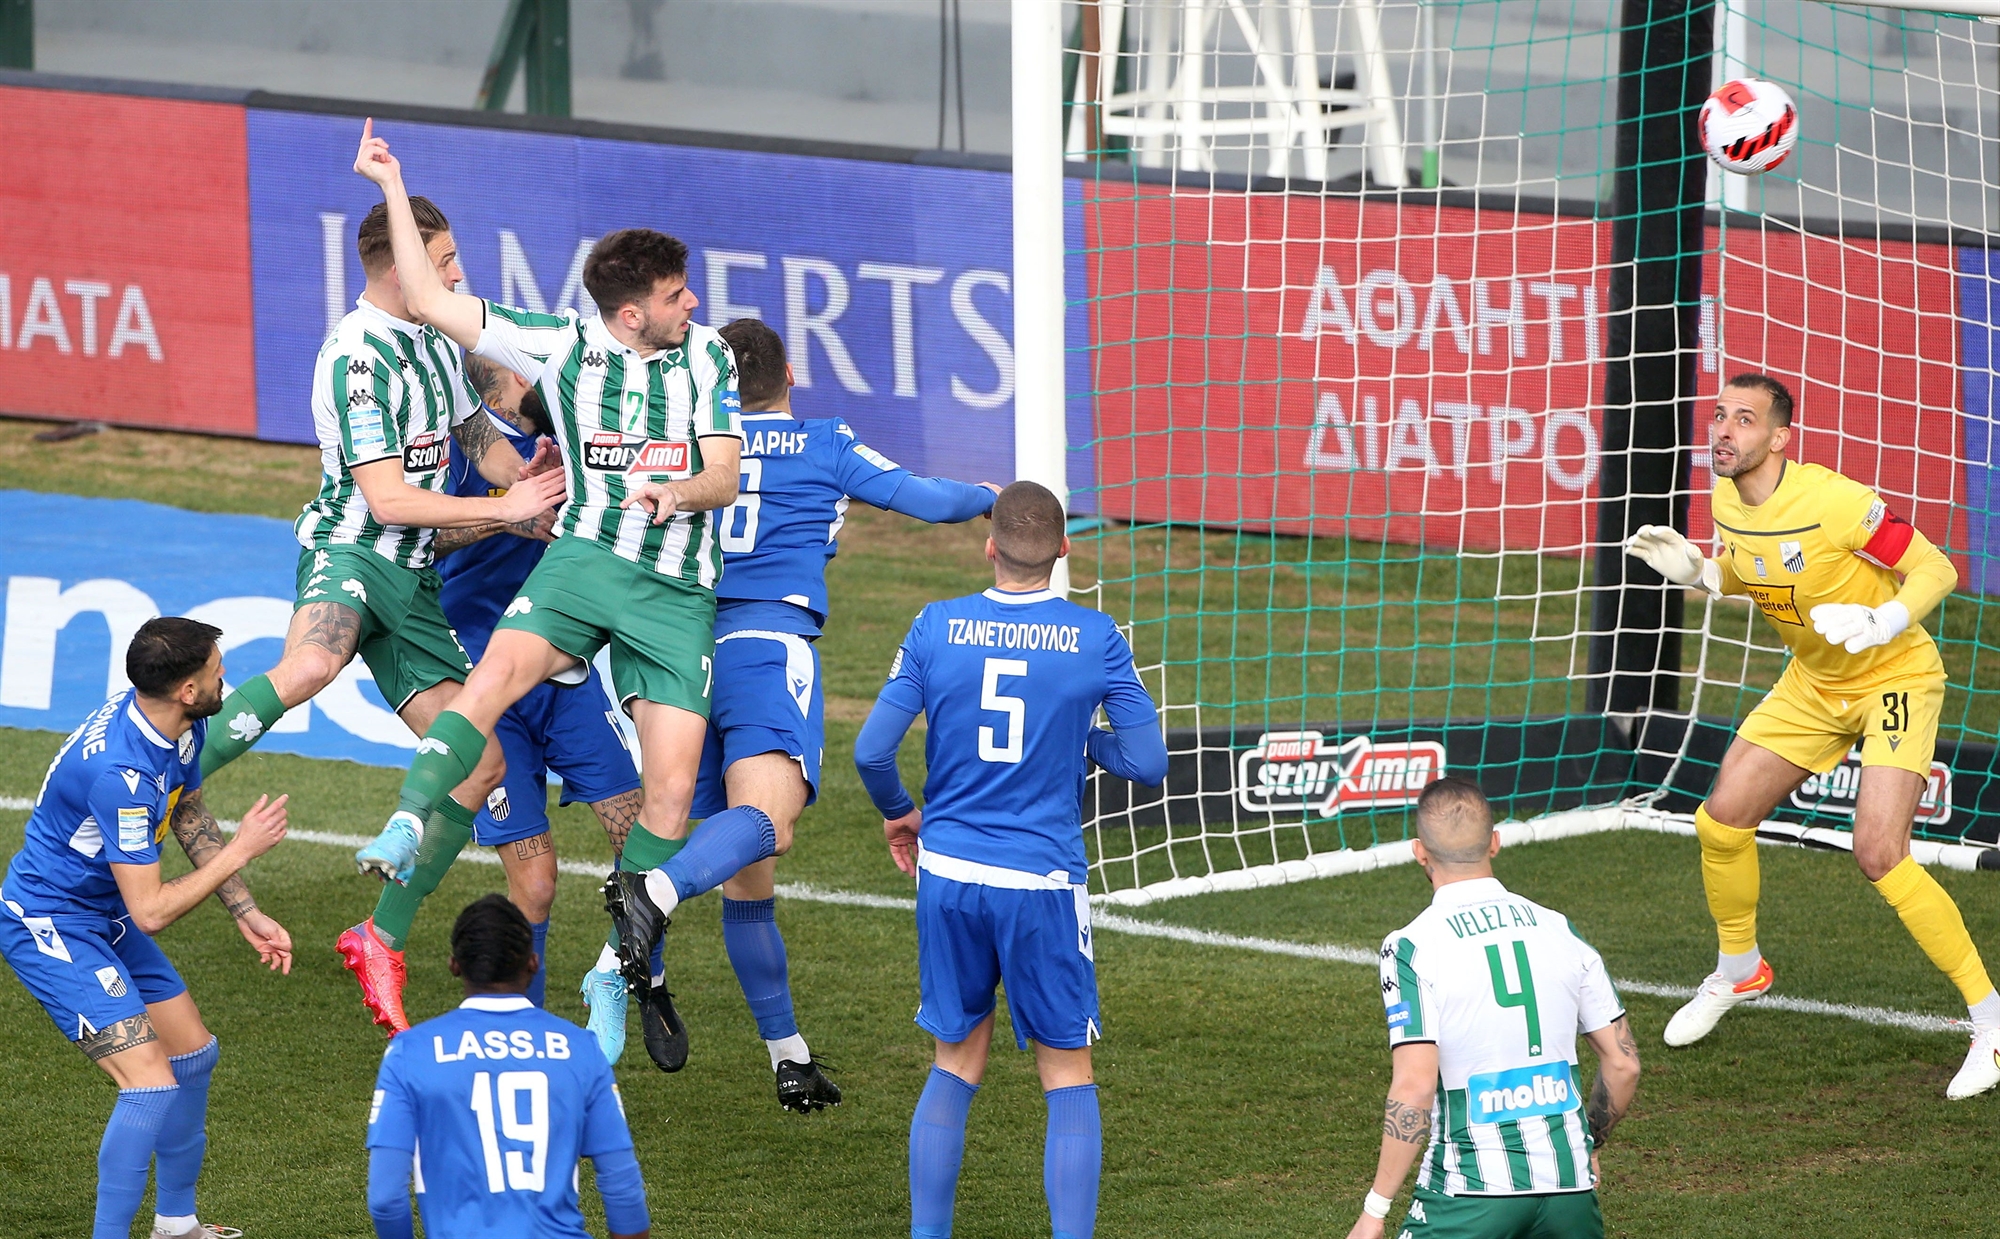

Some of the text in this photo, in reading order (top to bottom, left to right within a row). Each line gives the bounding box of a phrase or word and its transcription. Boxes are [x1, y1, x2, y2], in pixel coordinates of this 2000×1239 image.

[320, 212, 1014, 412] LMERTS
[626, 390, 645, 431] 7
[593, 434, 620, 445] pame
[1748, 590, 1770, 601] nter
[947, 618, 1081, 654] ΤΖΑΝΕΤΟΠΟΥΛΟΣ
[978, 657, 1028, 764] 5
[1882, 691, 1909, 732] 31
[1266, 740, 1312, 759] pame
[1446, 904, 1508, 939] VELEZ
[1484, 940, 1543, 1058] 4
[433, 1030, 571, 1064] LASS.B
[1478, 1075, 1569, 1114] molto
[470, 1070, 549, 1194] 19
